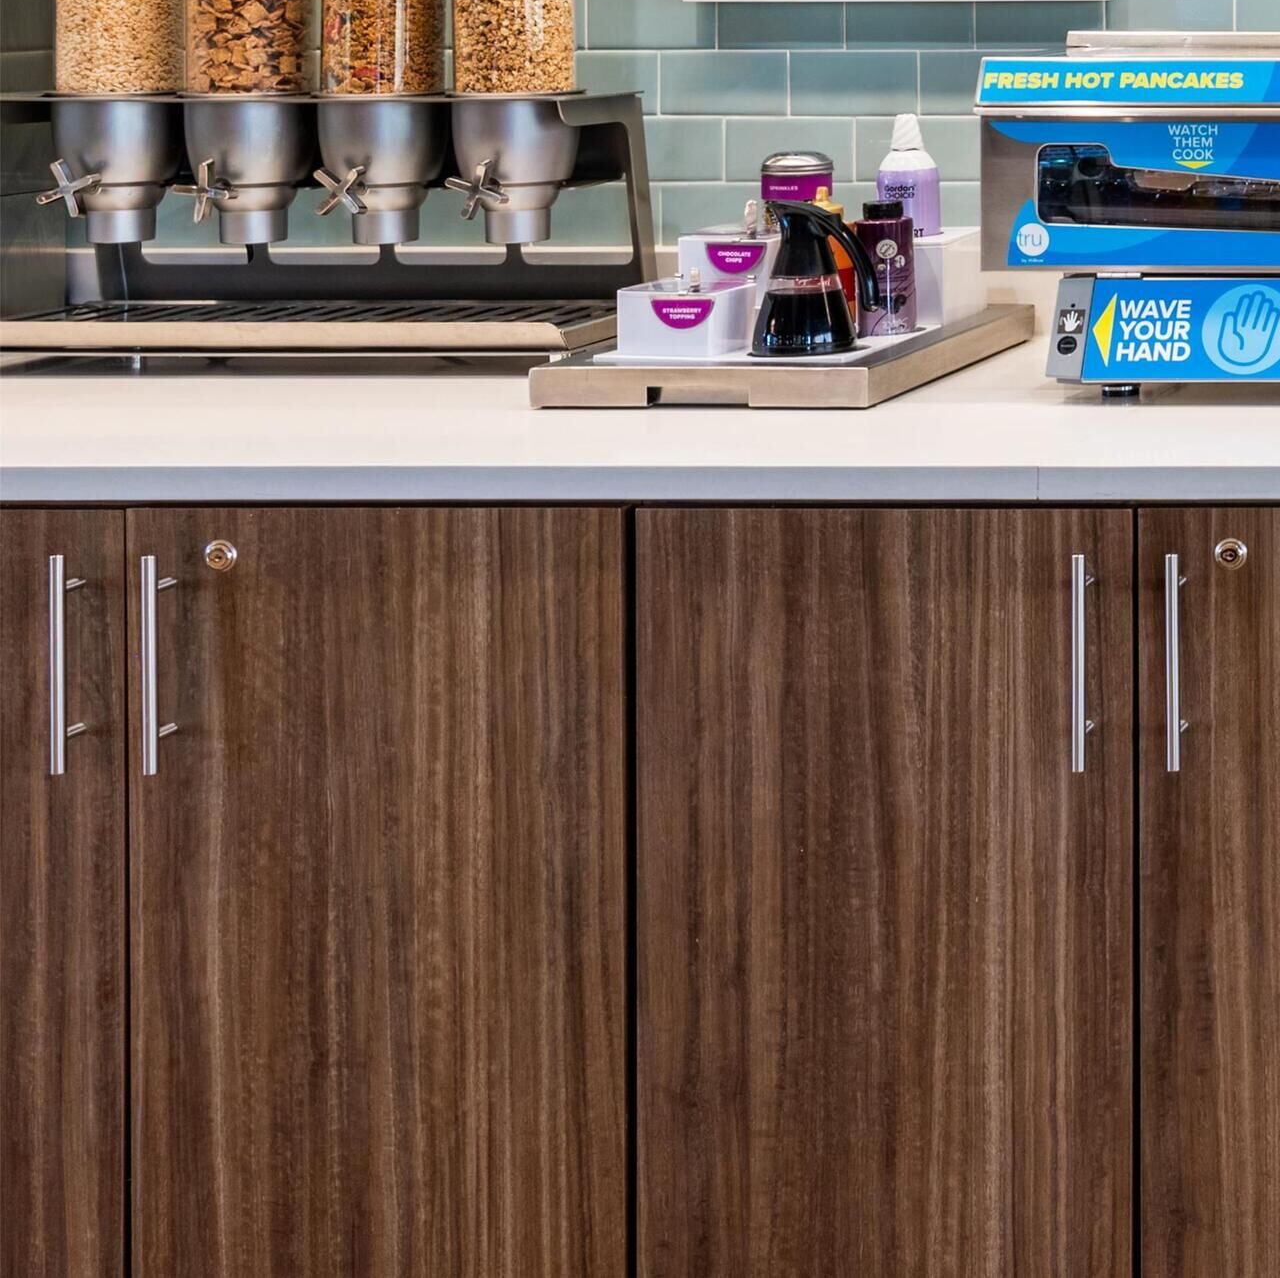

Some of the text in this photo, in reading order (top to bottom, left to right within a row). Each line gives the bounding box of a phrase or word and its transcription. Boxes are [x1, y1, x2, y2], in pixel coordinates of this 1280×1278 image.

[984, 72, 1244, 89] FRESH HOT PANCAKES
[1168, 124, 1218, 136] WATCH
[1173, 136, 1213, 147] THEM
[1172, 149, 1213, 160] COOK
[1018, 230, 1042, 247] tru
[1120, 300, 1192, 319] WAVE
[1119, 320, 1191, 340] YOUR
[1116, 342, 1191, 362] HAND
